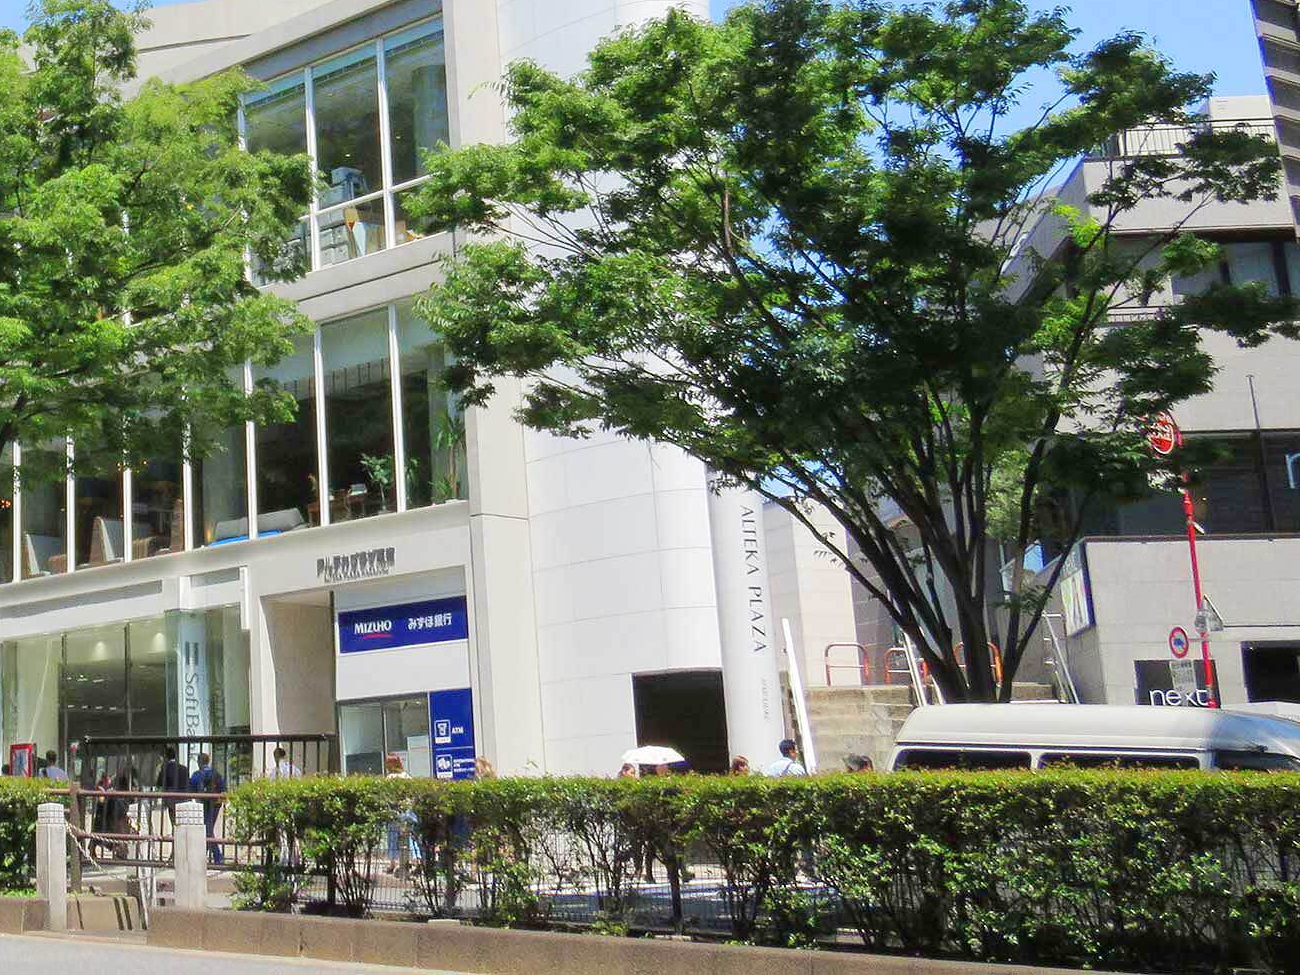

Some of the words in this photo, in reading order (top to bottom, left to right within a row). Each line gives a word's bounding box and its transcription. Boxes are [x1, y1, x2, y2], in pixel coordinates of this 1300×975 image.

[740, 505, 760, 575] ALTEKA
[353, 619, 392, 634] MIZUHO
[407, 612, 452, 631] みずほ銀行
[748, 586, 767, 652] PLAZA
[1149, 688, 1209, 706] next
